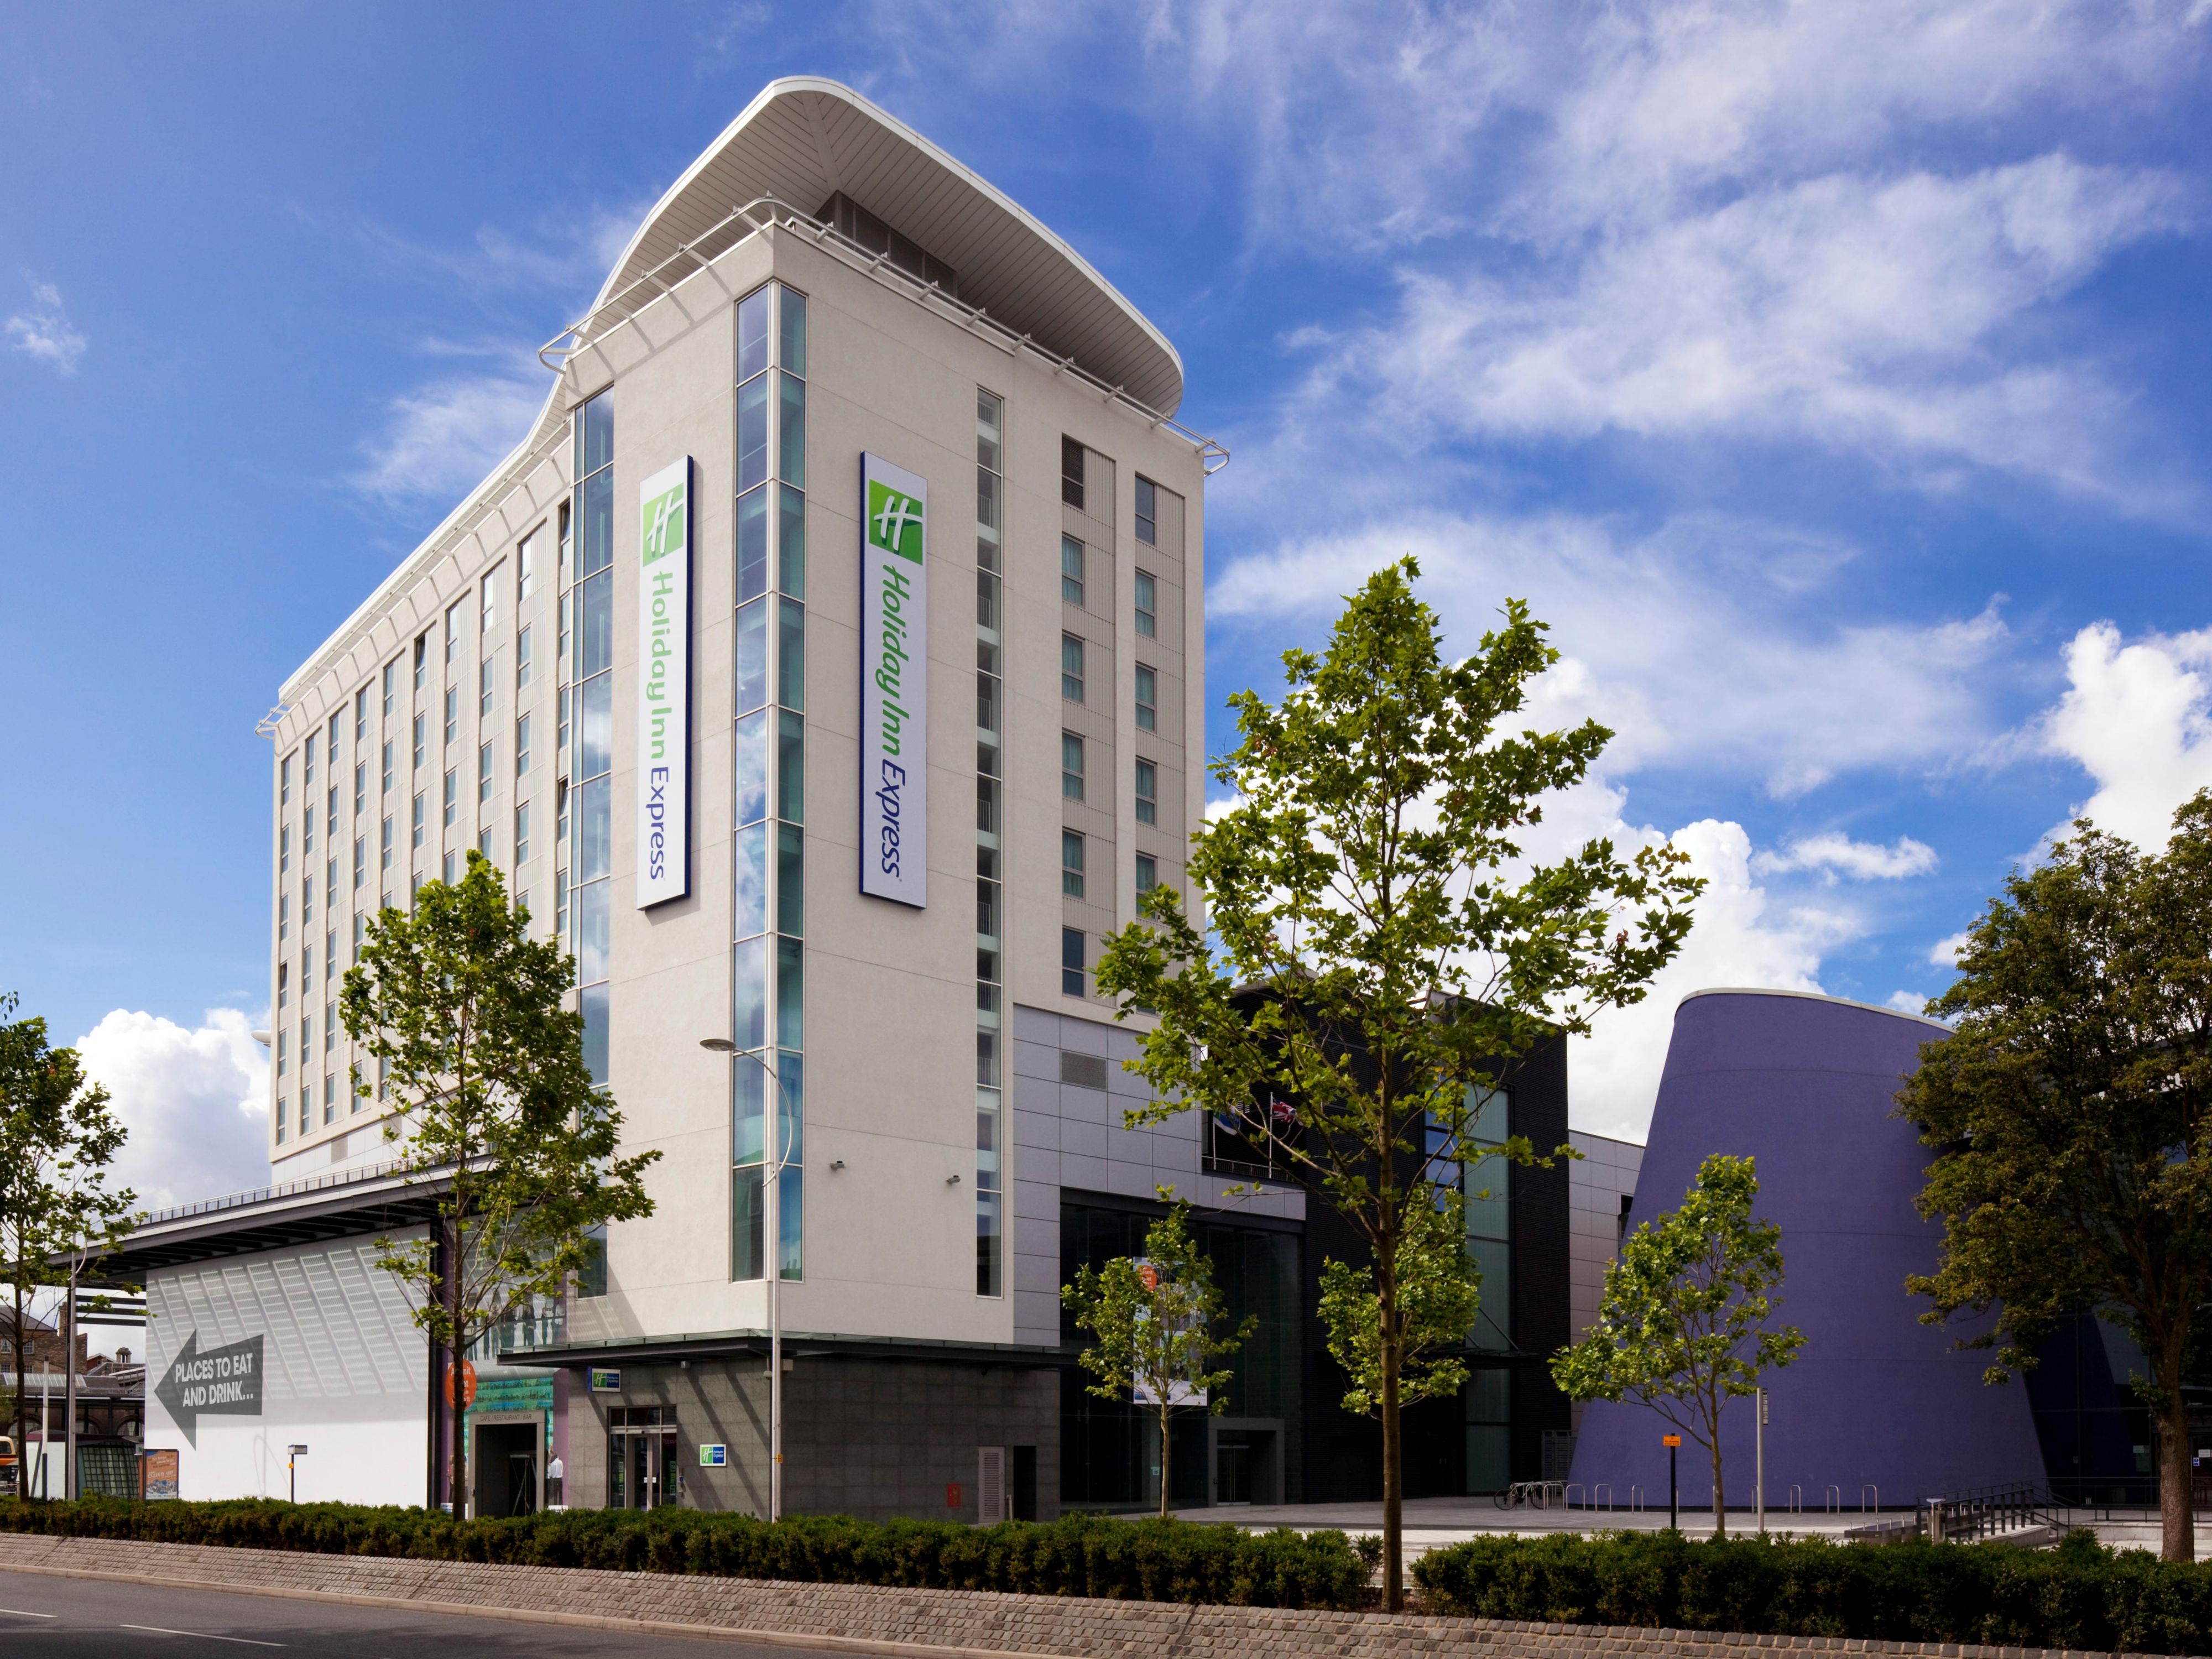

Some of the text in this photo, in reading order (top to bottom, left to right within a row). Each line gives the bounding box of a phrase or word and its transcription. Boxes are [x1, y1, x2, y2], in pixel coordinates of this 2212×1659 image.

[646, 571, 673, 880] Holiday Inn Express
[875, 564, 910, 878] Holiday Inn Express
[175, 1353, 253, 1383] PLACES TO EAT
[182, 1380, 254, 1407] AND DRINK...
